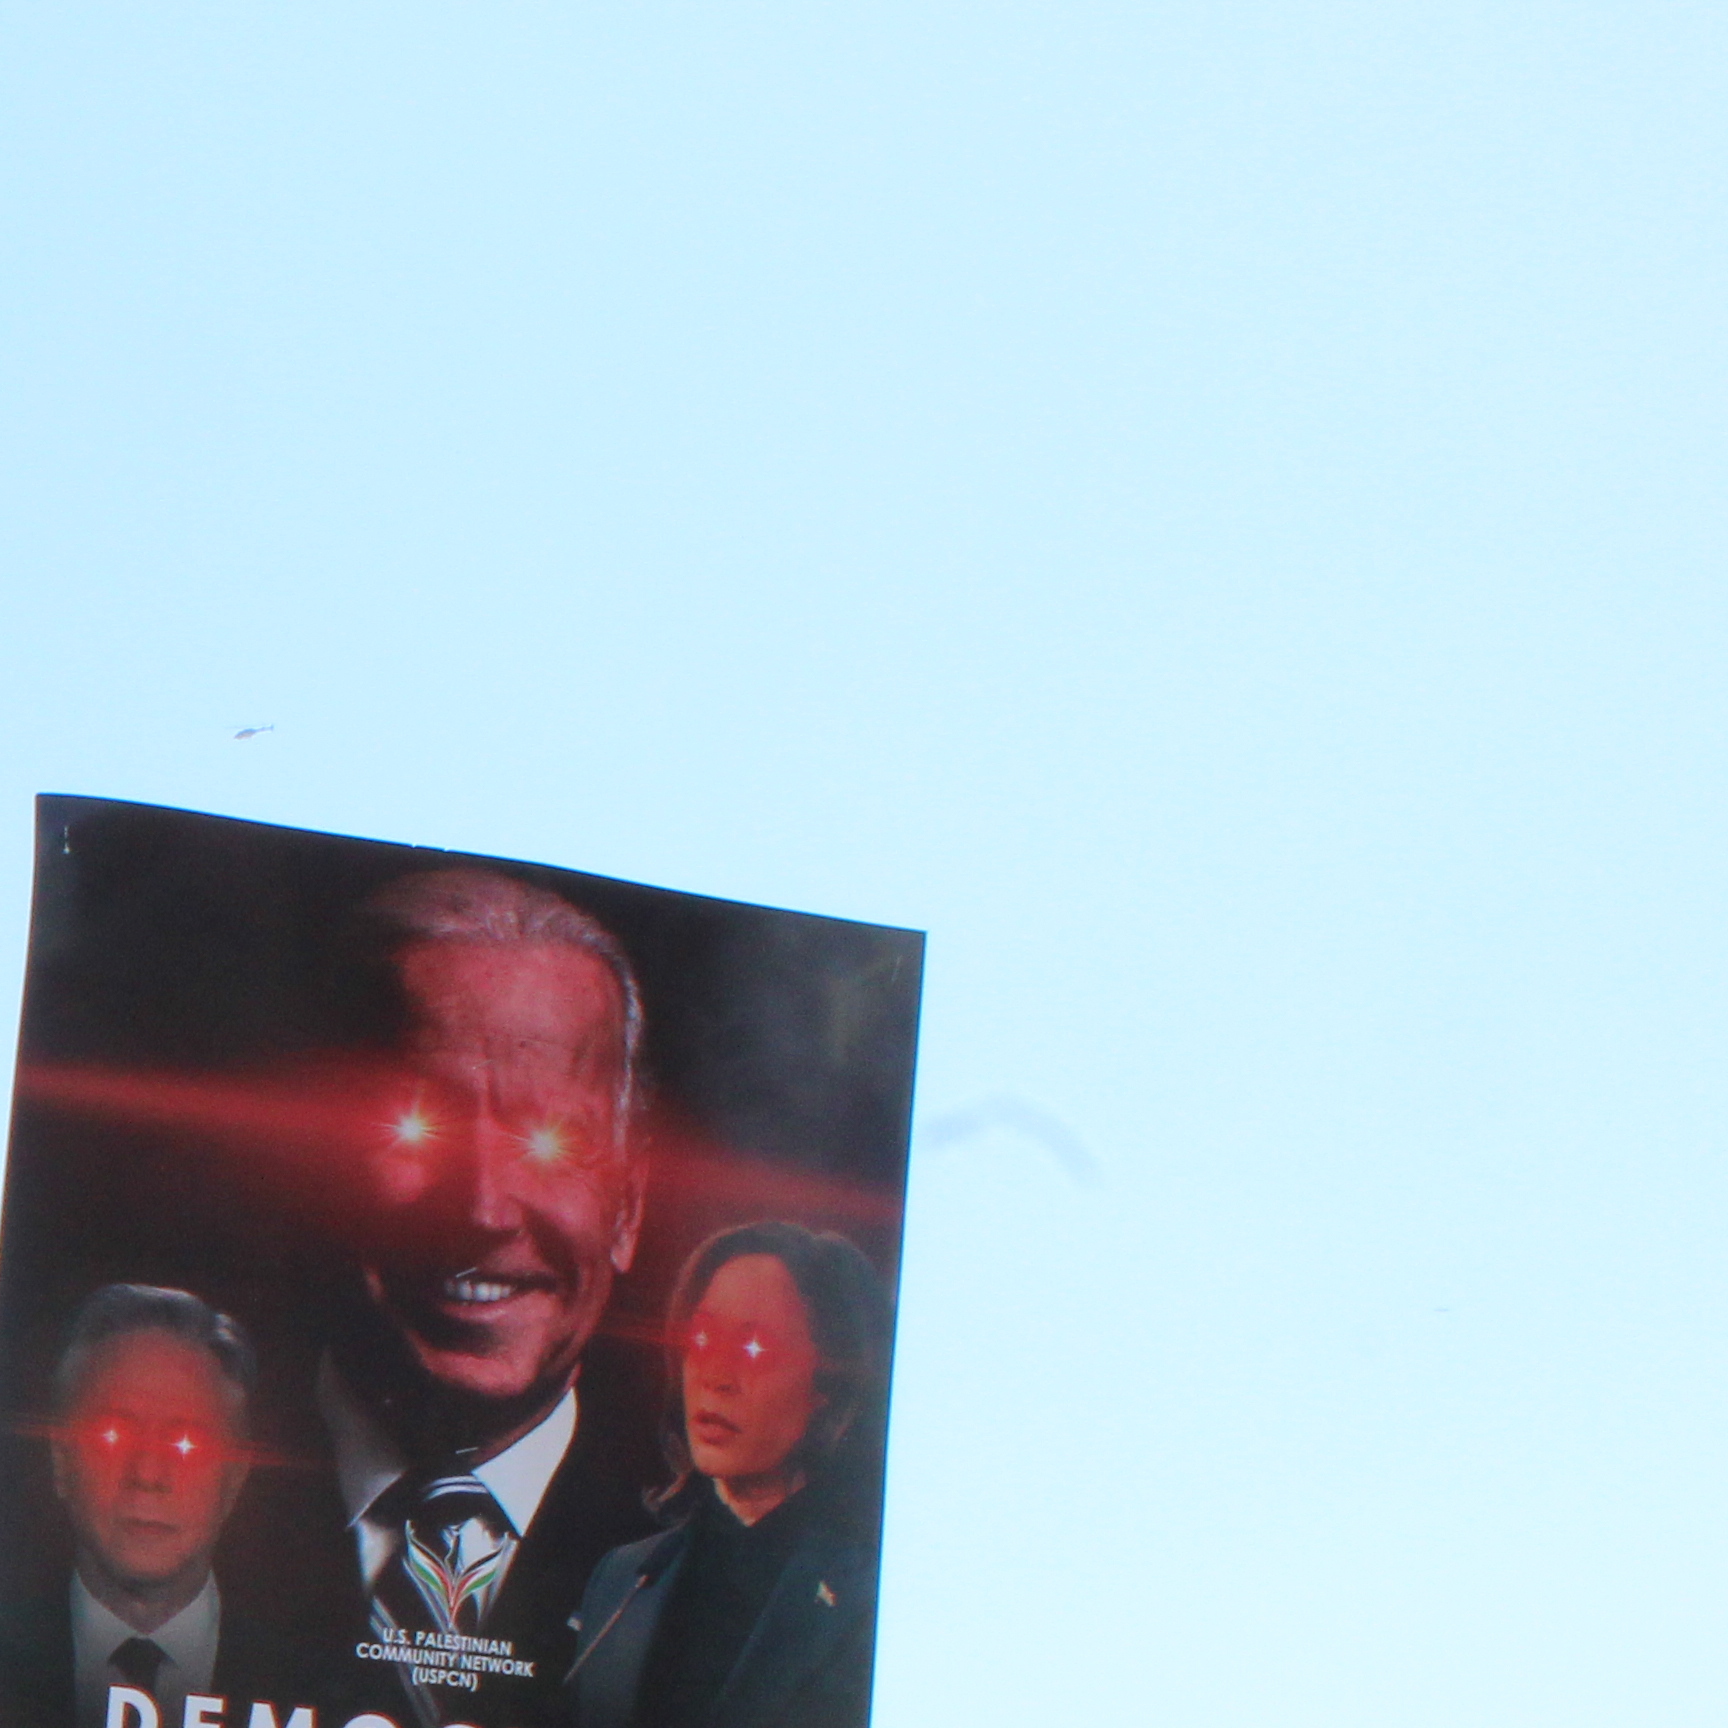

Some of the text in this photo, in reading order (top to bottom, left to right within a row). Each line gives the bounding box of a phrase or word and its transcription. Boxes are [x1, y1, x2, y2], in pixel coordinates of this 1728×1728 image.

[382, 1628, 512, 1656] U.S. PALESTINIAN
[356, 1643, 534, 1678] COMMUNITY NETWORK
[412, 1667, 479, 1692] (USPCN)
